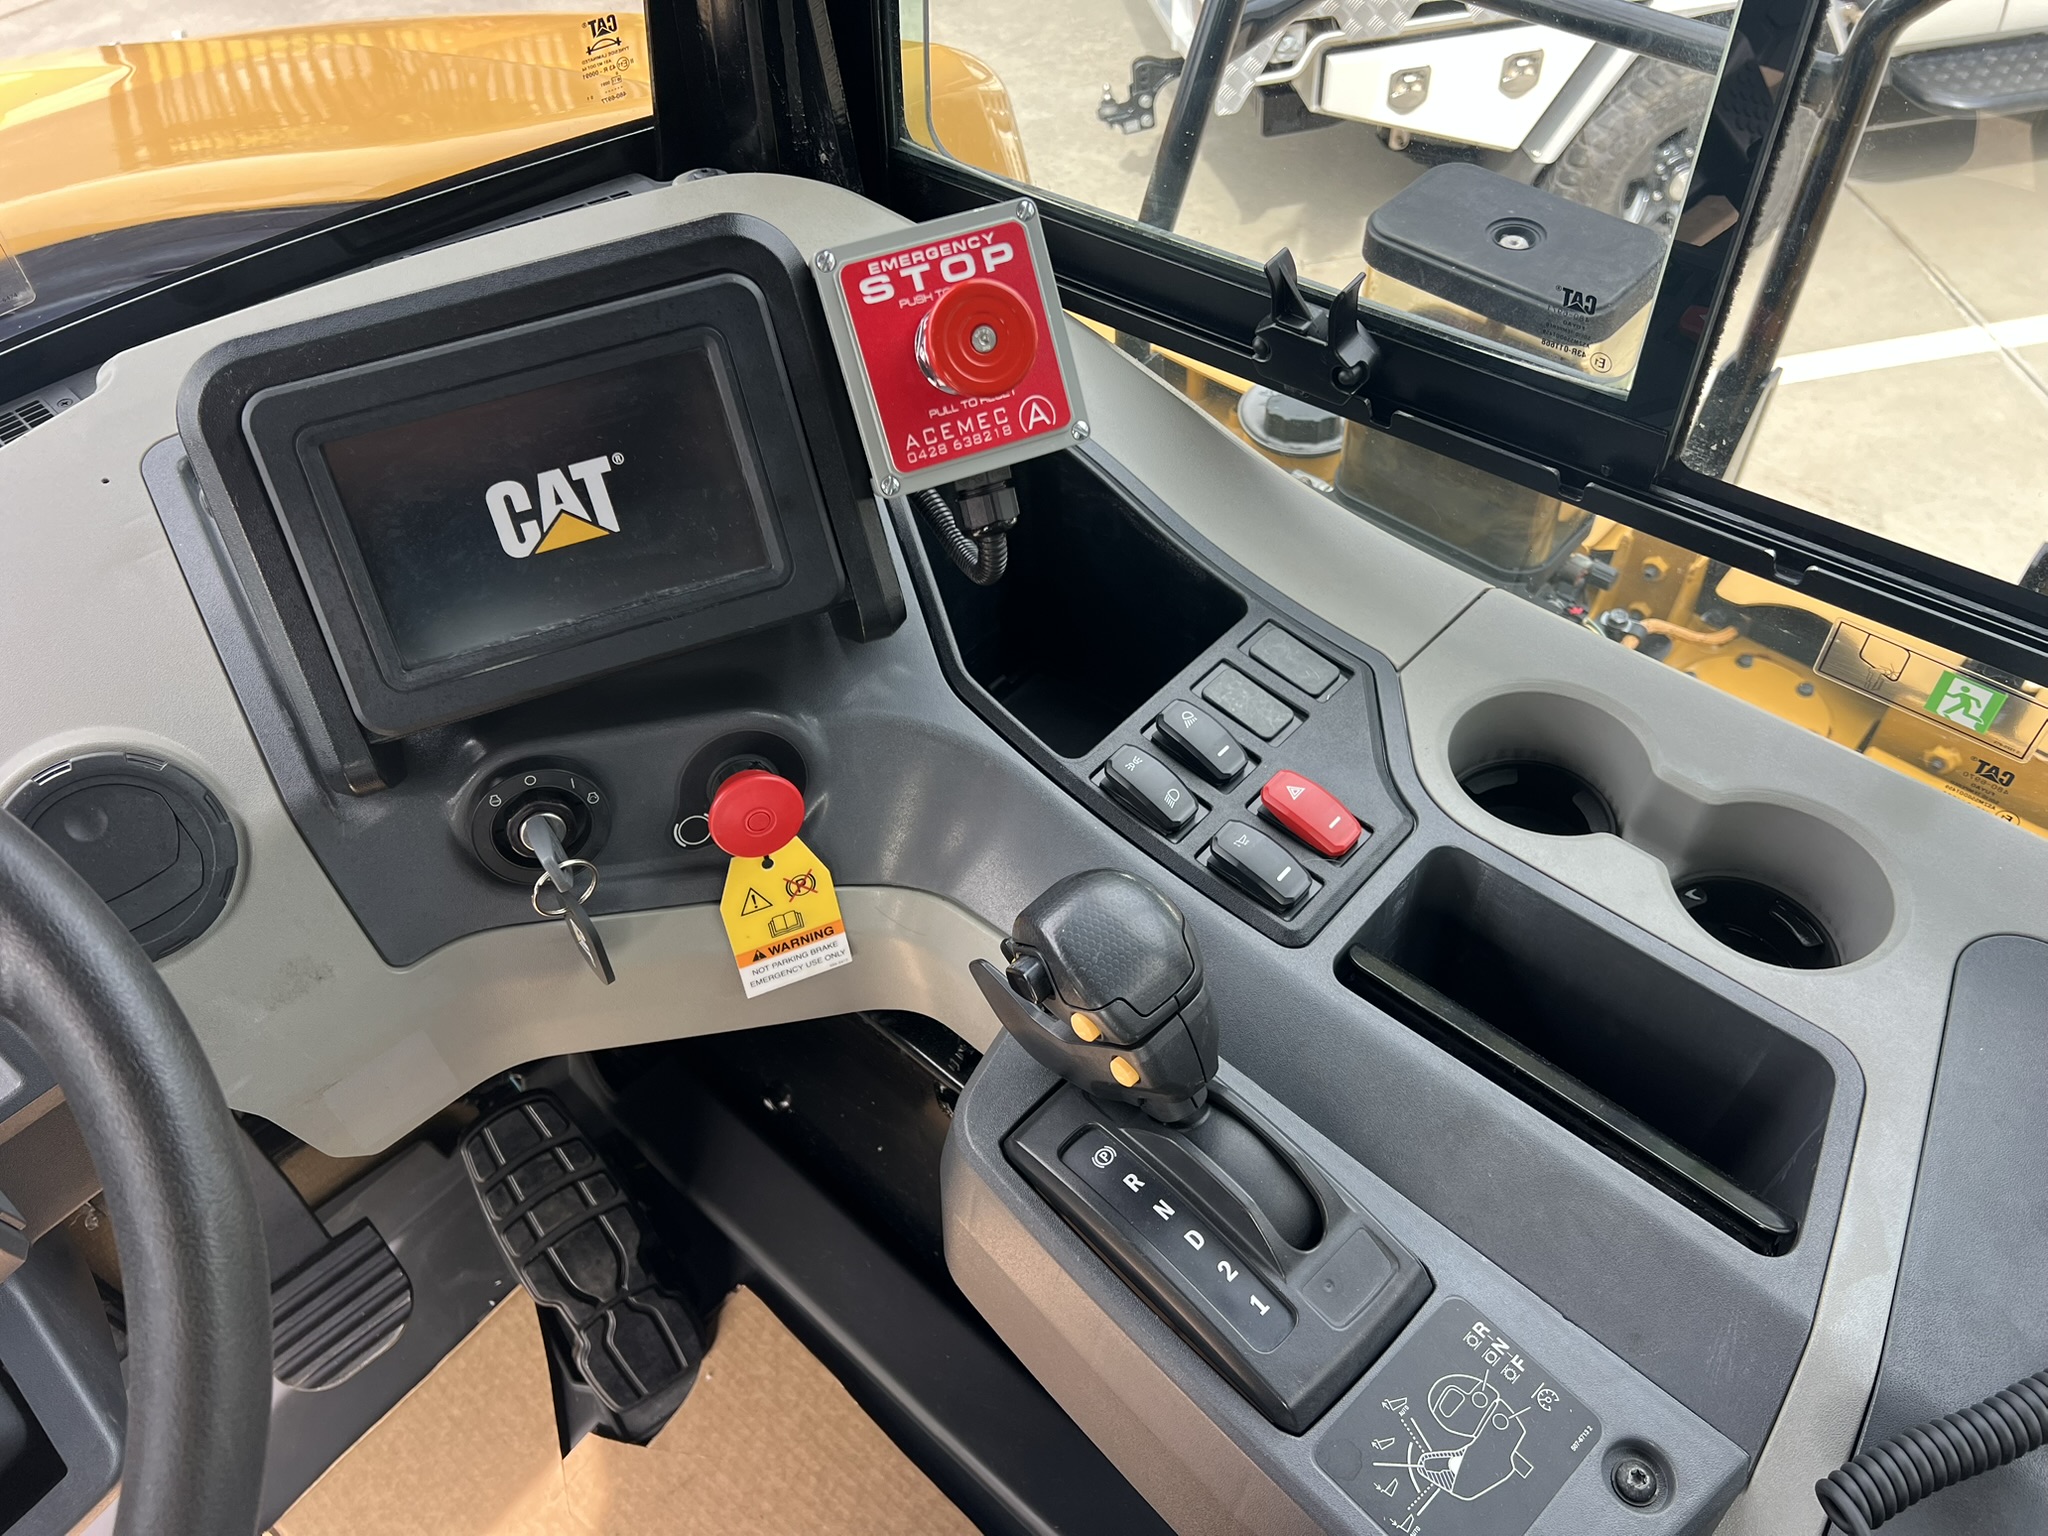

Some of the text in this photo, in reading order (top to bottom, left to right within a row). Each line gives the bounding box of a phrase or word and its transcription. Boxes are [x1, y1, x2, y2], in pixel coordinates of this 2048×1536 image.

[868, 232, 995, 276] EMERGENCY
[859, 242, 1014, 304] STOP
[899, 292, 933, 309] PUSH
[928, 398, 978, 420] PULL TO
[906, 408, 1008, 450] ACEMEC
[908, 426, 1012, 464] 0428 638218
[768, 926, 834, 956] WARNING
[750, 965, 804, 988] EMERGENCY
[806, 958, 823, 968] USE
[825, 949, 846, 962] ONLY
[752, 941, 839, 976] NOT PARKING BRAKE
[1122, 1173, 1146, 1193] R
[1152, 1199, 1176, 1220] N
[1184, 1230, 1205, 1250] D
[1218, 1260, 1239, 1282] 2
[1250, 1294, 1270, 1316] 1
[1472, 1321, 1490, 1340] R
[1491, 1337, 1510, 1356] N
[1510, 1354, 1526, 1372] F
